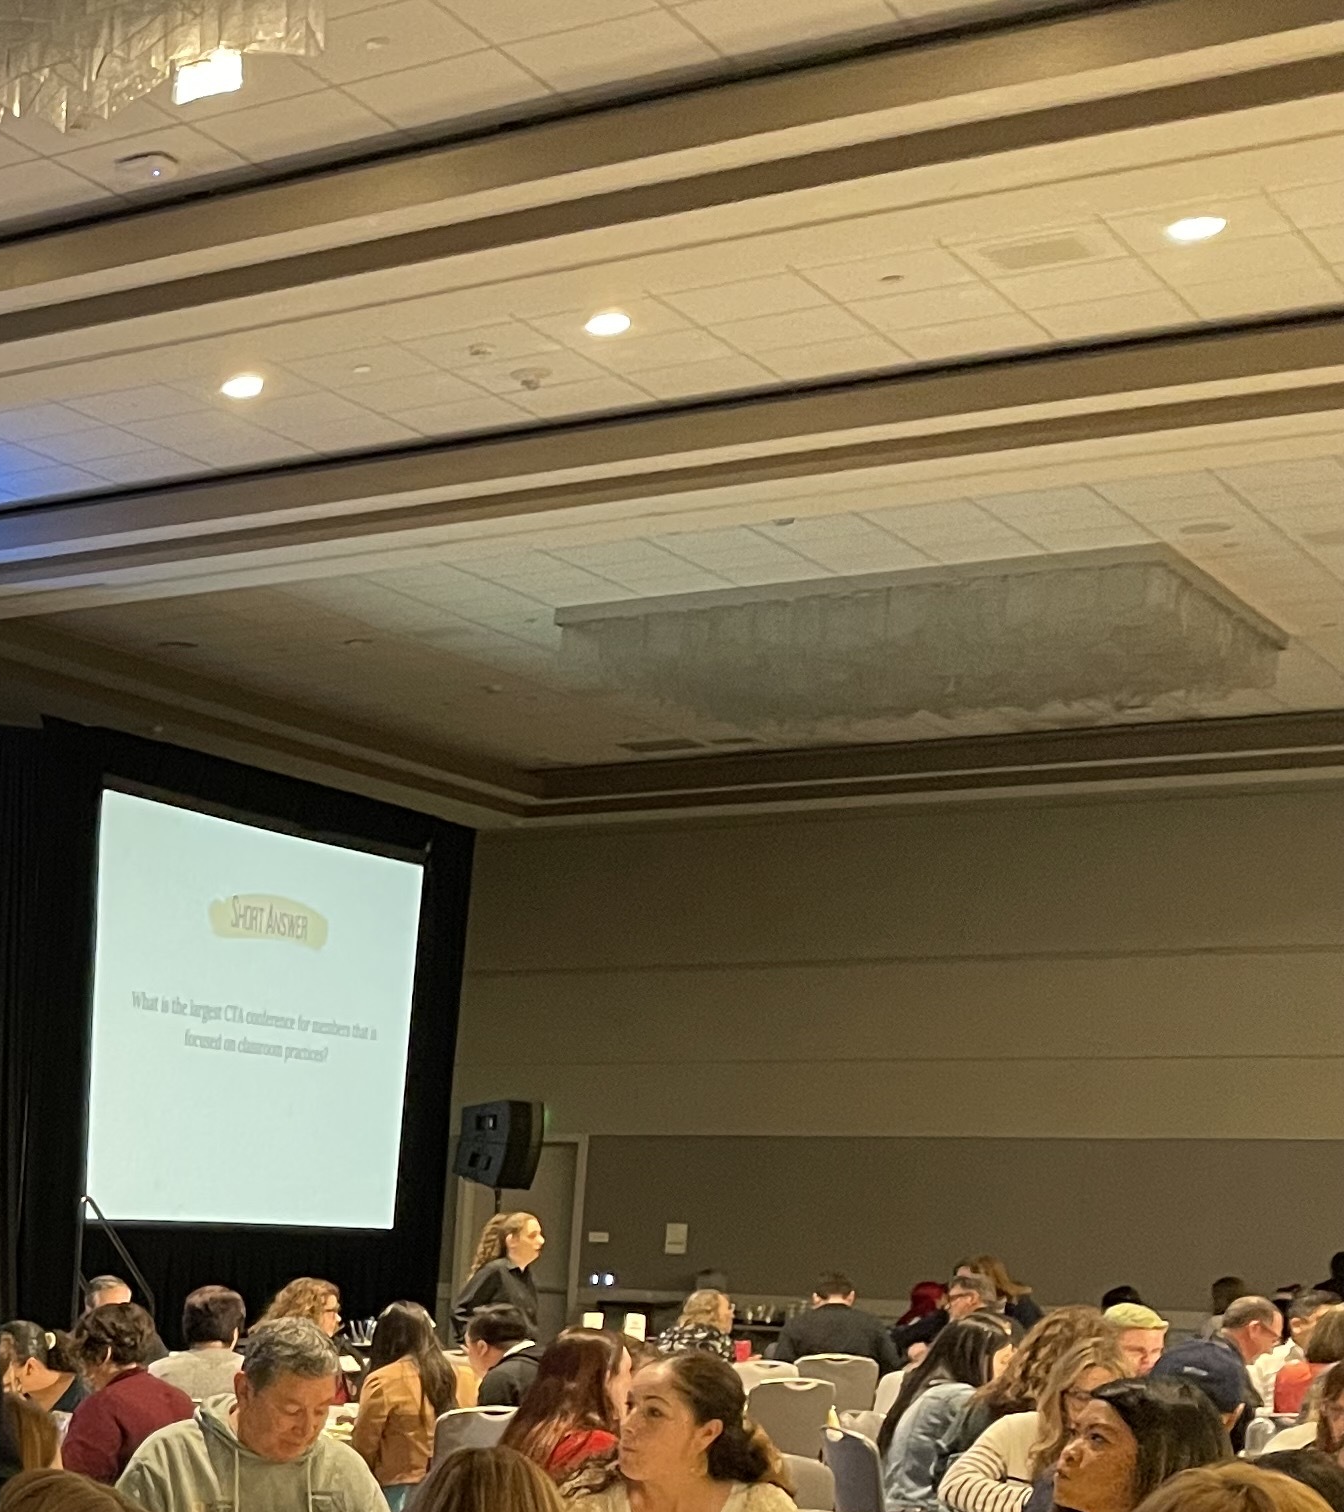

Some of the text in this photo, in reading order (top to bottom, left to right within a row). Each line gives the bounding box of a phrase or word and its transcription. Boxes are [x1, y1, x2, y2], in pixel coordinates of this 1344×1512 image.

[131, 990, 159, 1012] What
[171, 996, 188, 1016] the
[224, 1004, 244, 1024] CTA
[245, 1010, 296, 1031] conference
[351, 1023, 369, 1040] that
[183, 1028, 222, 1051] focused
[223, 1038, 236, 1052] on
